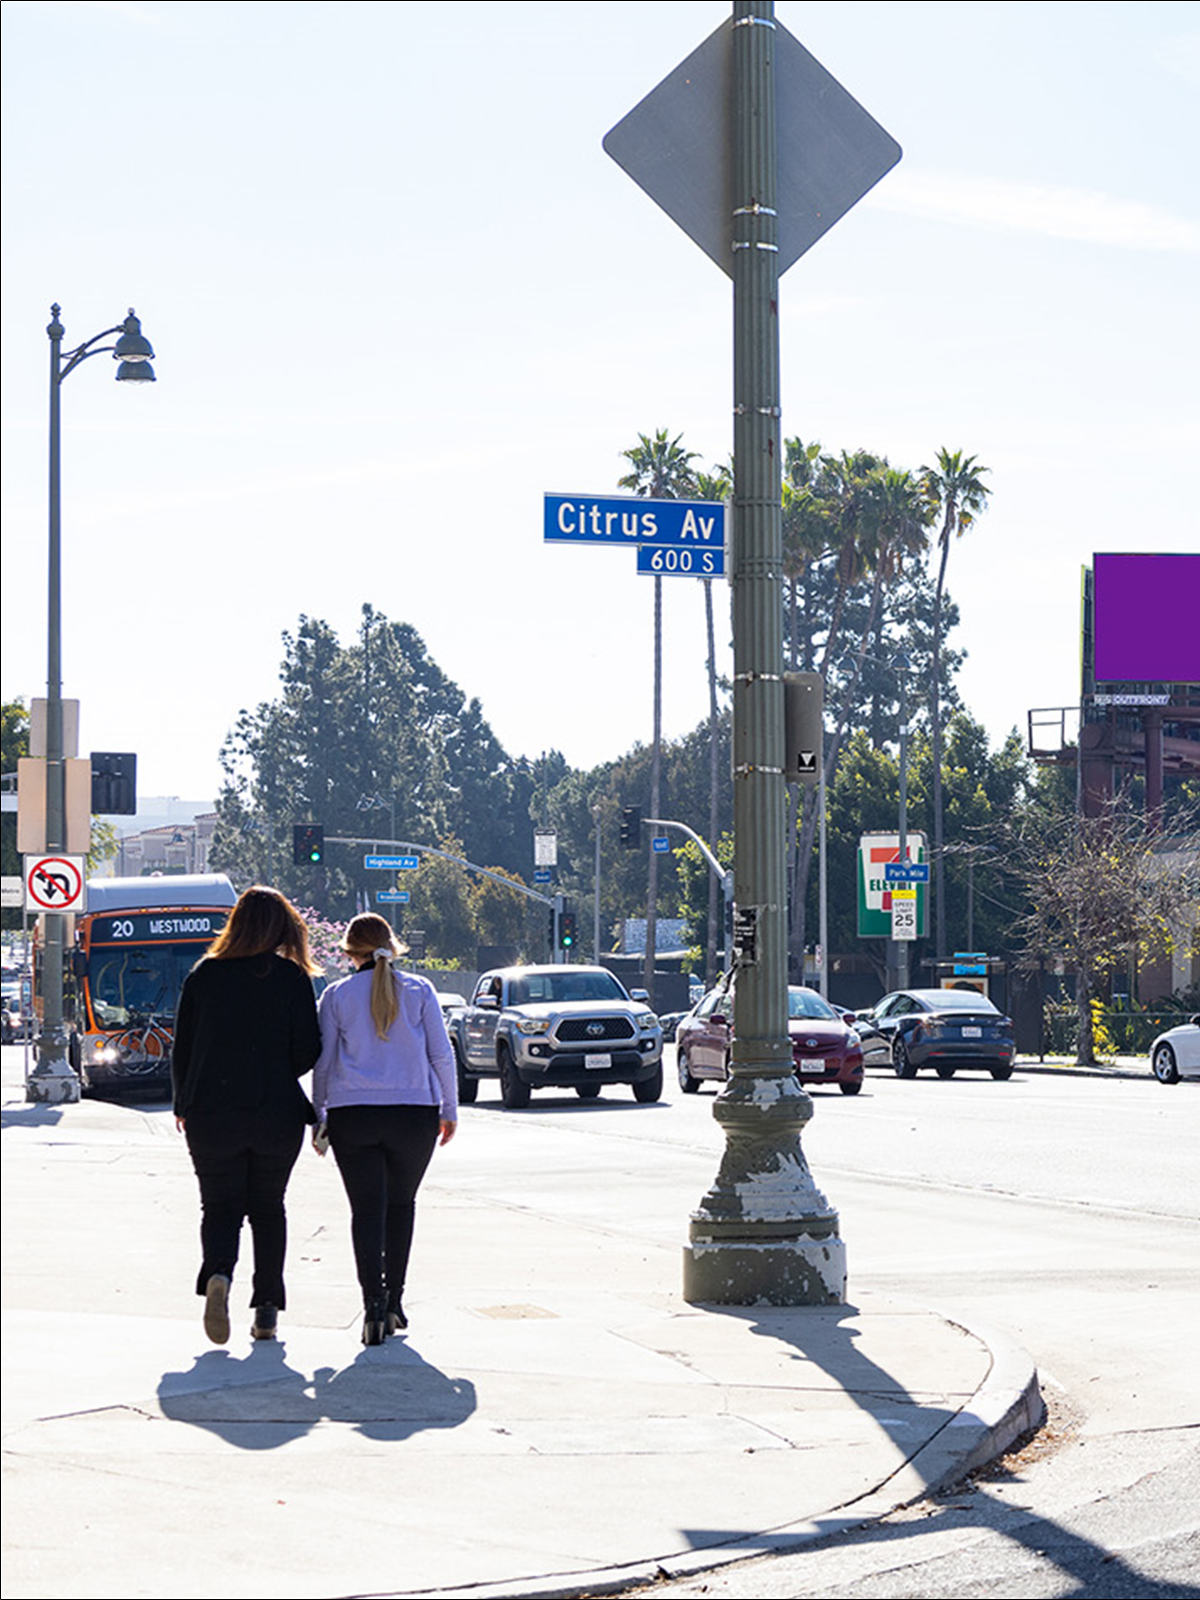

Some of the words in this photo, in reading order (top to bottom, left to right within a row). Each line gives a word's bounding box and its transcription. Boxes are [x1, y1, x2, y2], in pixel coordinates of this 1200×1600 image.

[558, 502, 658, 537] Citrus
[680, 509, 715, 540] Av
[651, 549, 692, 571] 600
[703, 552, 714, 573] S
[889, 869, 906, 877] Park
[112, 920, 134, 937] 20
[150, 917, 210, 934] WESTWOOD
[894, 914, 914, 926] 25
